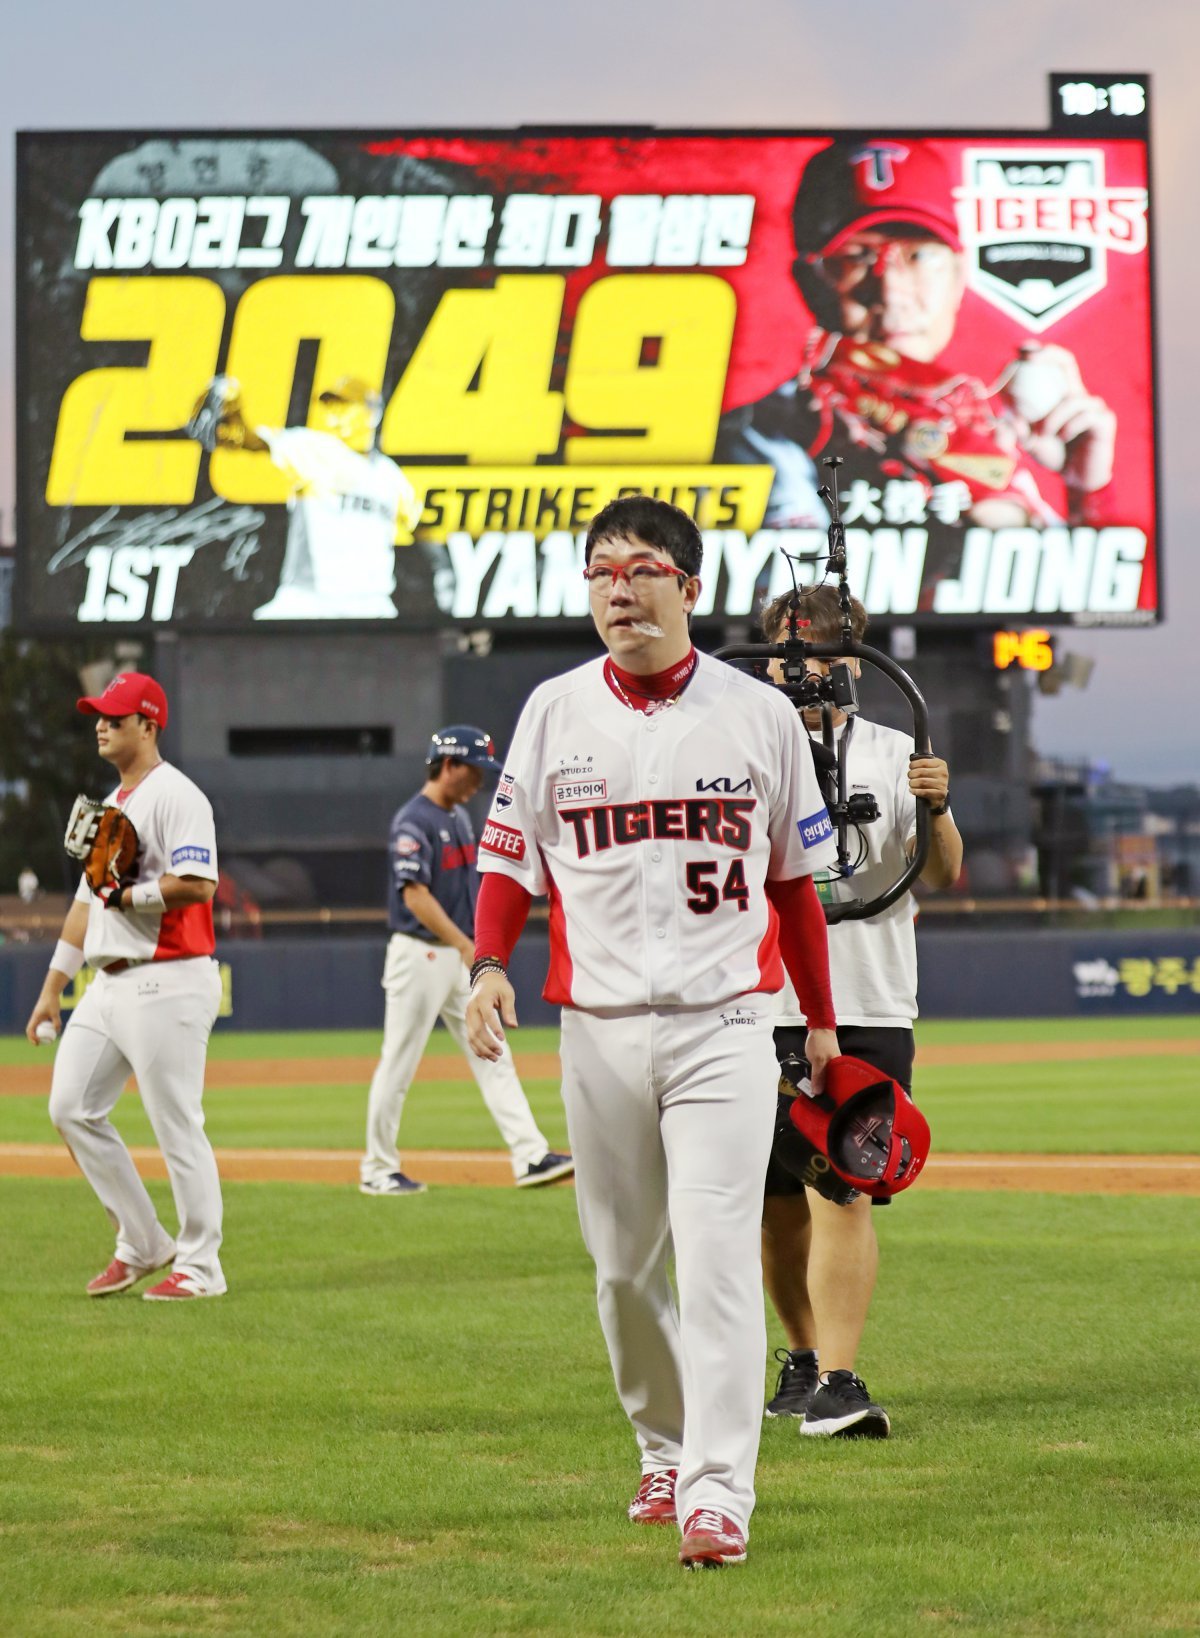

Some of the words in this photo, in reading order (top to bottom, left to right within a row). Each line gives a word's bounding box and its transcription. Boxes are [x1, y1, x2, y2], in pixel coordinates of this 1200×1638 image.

[73, 196, 291, 270] KBO리그
[45, 274, 738, 506] 2049
[419, 487, 598, 527] STRIKE
[616, 486, 742, 527] TS
[77, 544, 196, 622] 1ST
[445, 530, 600, 618] YAN
[932, 526, 1148, 614] JONG
[556, 784, 604, 800] 금호타이어
[560, 767, 593, 776] STUDIO
[482, 824, 523, 854] COFFEE
[558, 799, 757, 860] TIGERS
[803, 815, 833, 842] 현대차
[686, 858, 750, 915] 54
[724, 1018, 756, 1026] STUDIO
